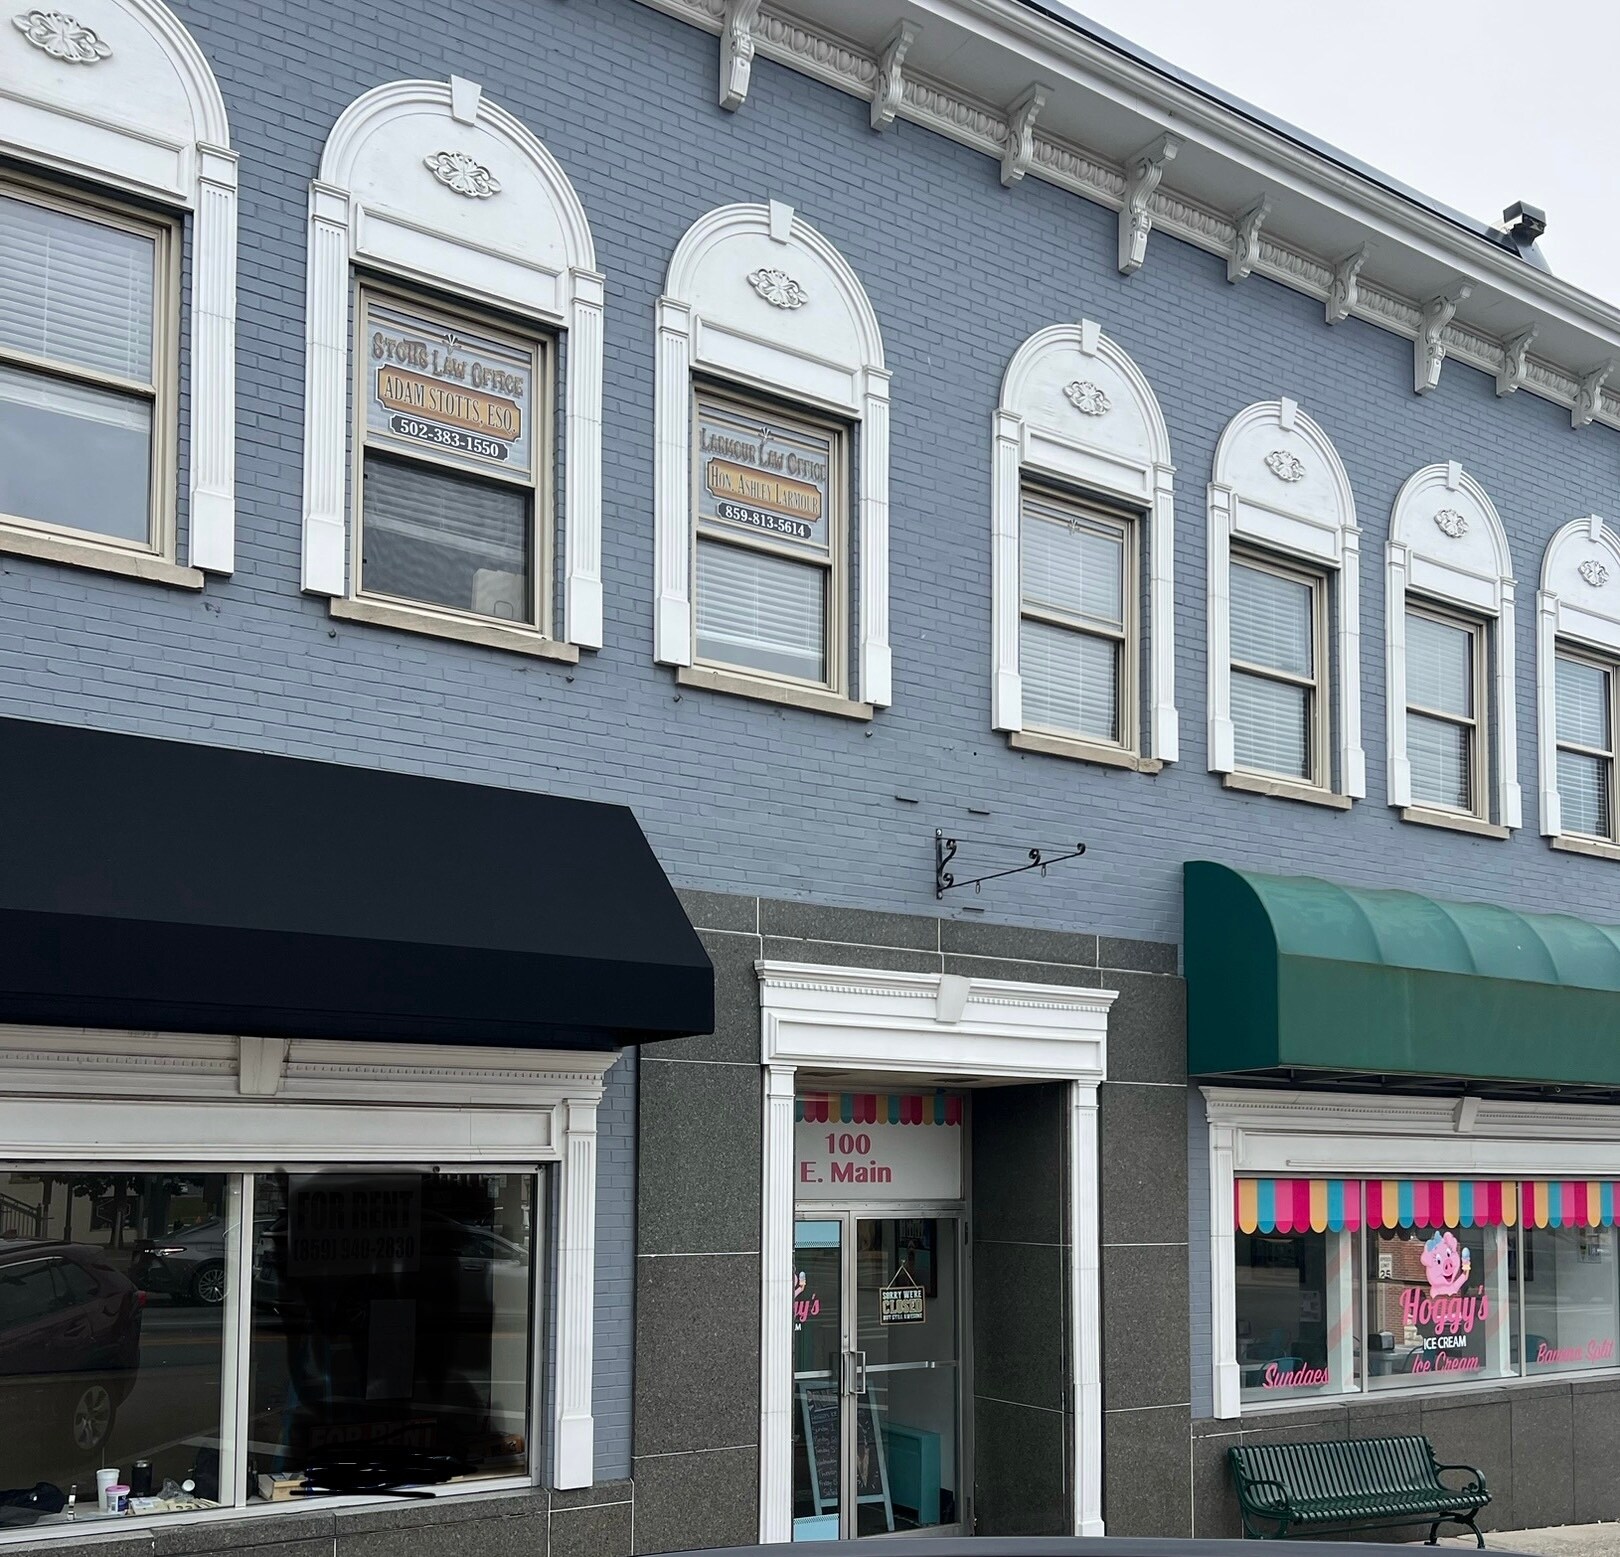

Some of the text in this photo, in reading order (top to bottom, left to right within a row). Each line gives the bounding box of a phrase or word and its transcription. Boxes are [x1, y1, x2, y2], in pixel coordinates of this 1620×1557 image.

[384, 375, 517, 435] ADAM STOTTS, ESQ.
[400, 418, 499, 457] 502-383-1550
[725, 505, 805, 537] 859-813-5614
[825, 1133, 871, 1155] 100
[800, 1160, 892, 1183] E. Main
[882, 1298, 923, 1315] CLOSED
[1400, 1285, 1489, 1334] Hoggy's
[1423, 1335, 1467, 1350] ICE CREAM
[1262, 1361, 1330, 1389] Sundaes
[1411, 1351, 1480, 1375] Ice Cream
